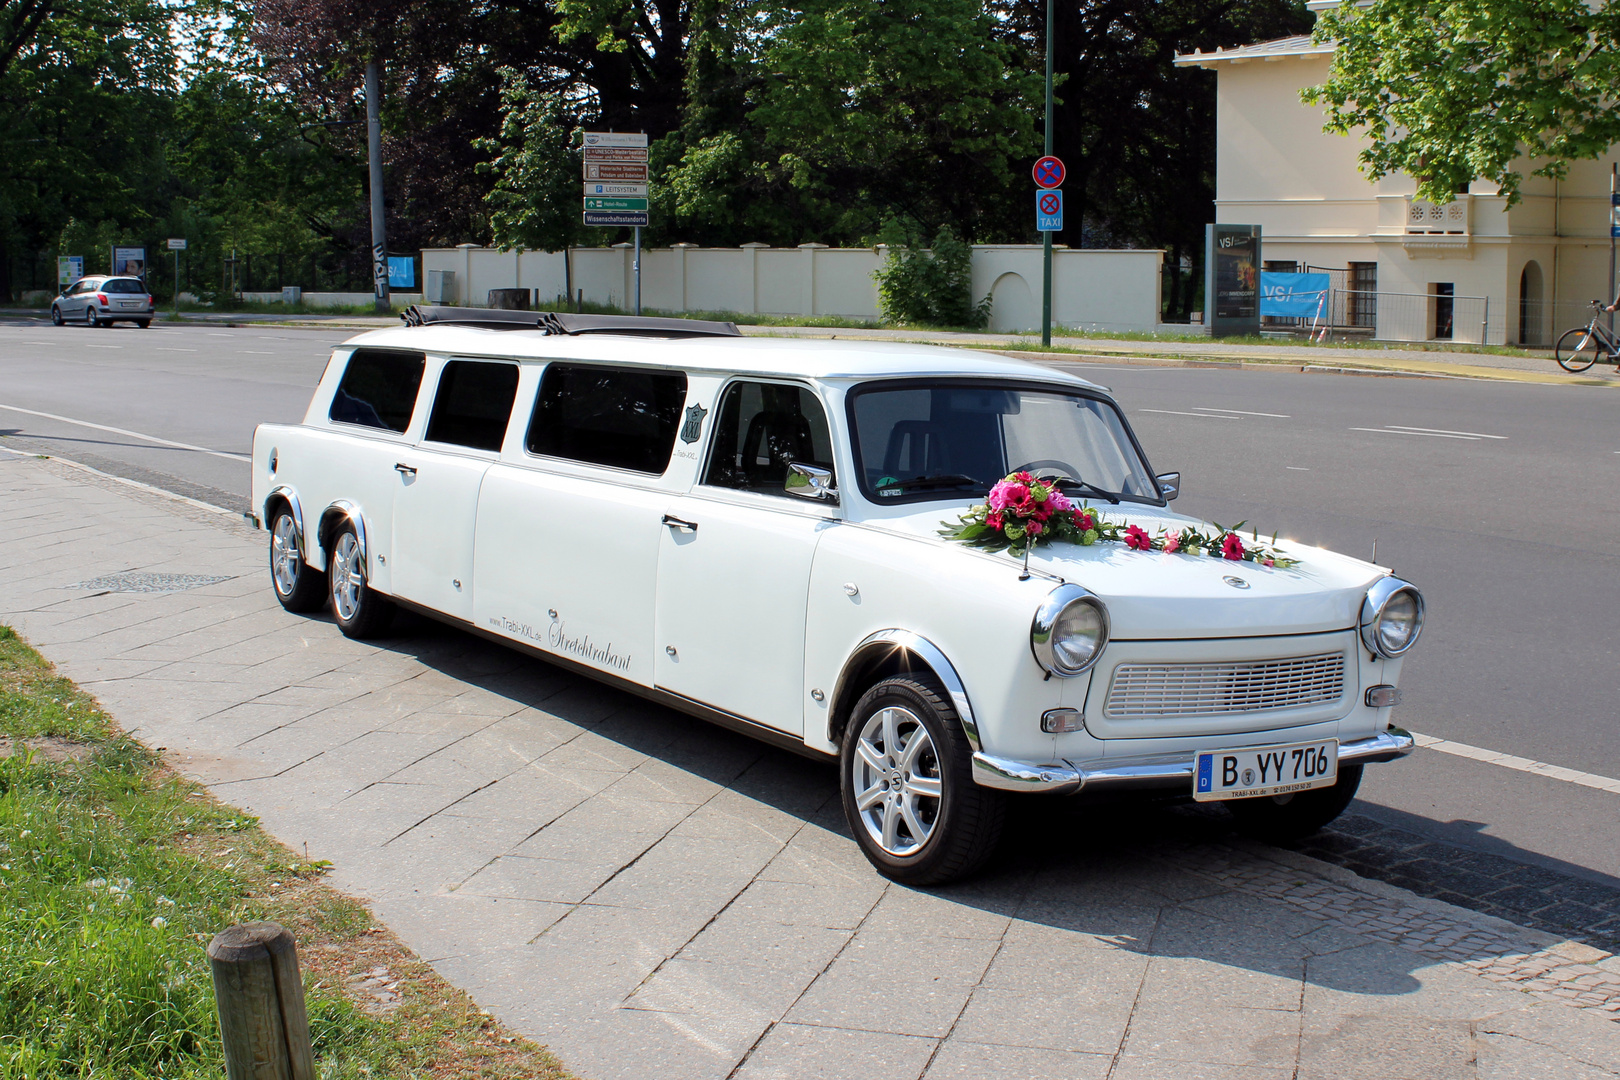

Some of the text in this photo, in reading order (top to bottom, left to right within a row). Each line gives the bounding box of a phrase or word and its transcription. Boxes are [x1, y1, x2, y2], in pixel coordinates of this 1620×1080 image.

[606, 185, 637, 193] LEITSYSTEM
[586, 215, 646, 223] Wissenschaftsstandorte
[1040, 218, 1060, 227] TAXI
[682, 421, 699, 439] XXL
[489, 616, 542, 642] www.Trabi-XXL.de
[548, 620, 631, 672] Stretchtrabant
[1222, 746, 1328, 786] B YY 706
[1201, 778, 1207, 787] D
